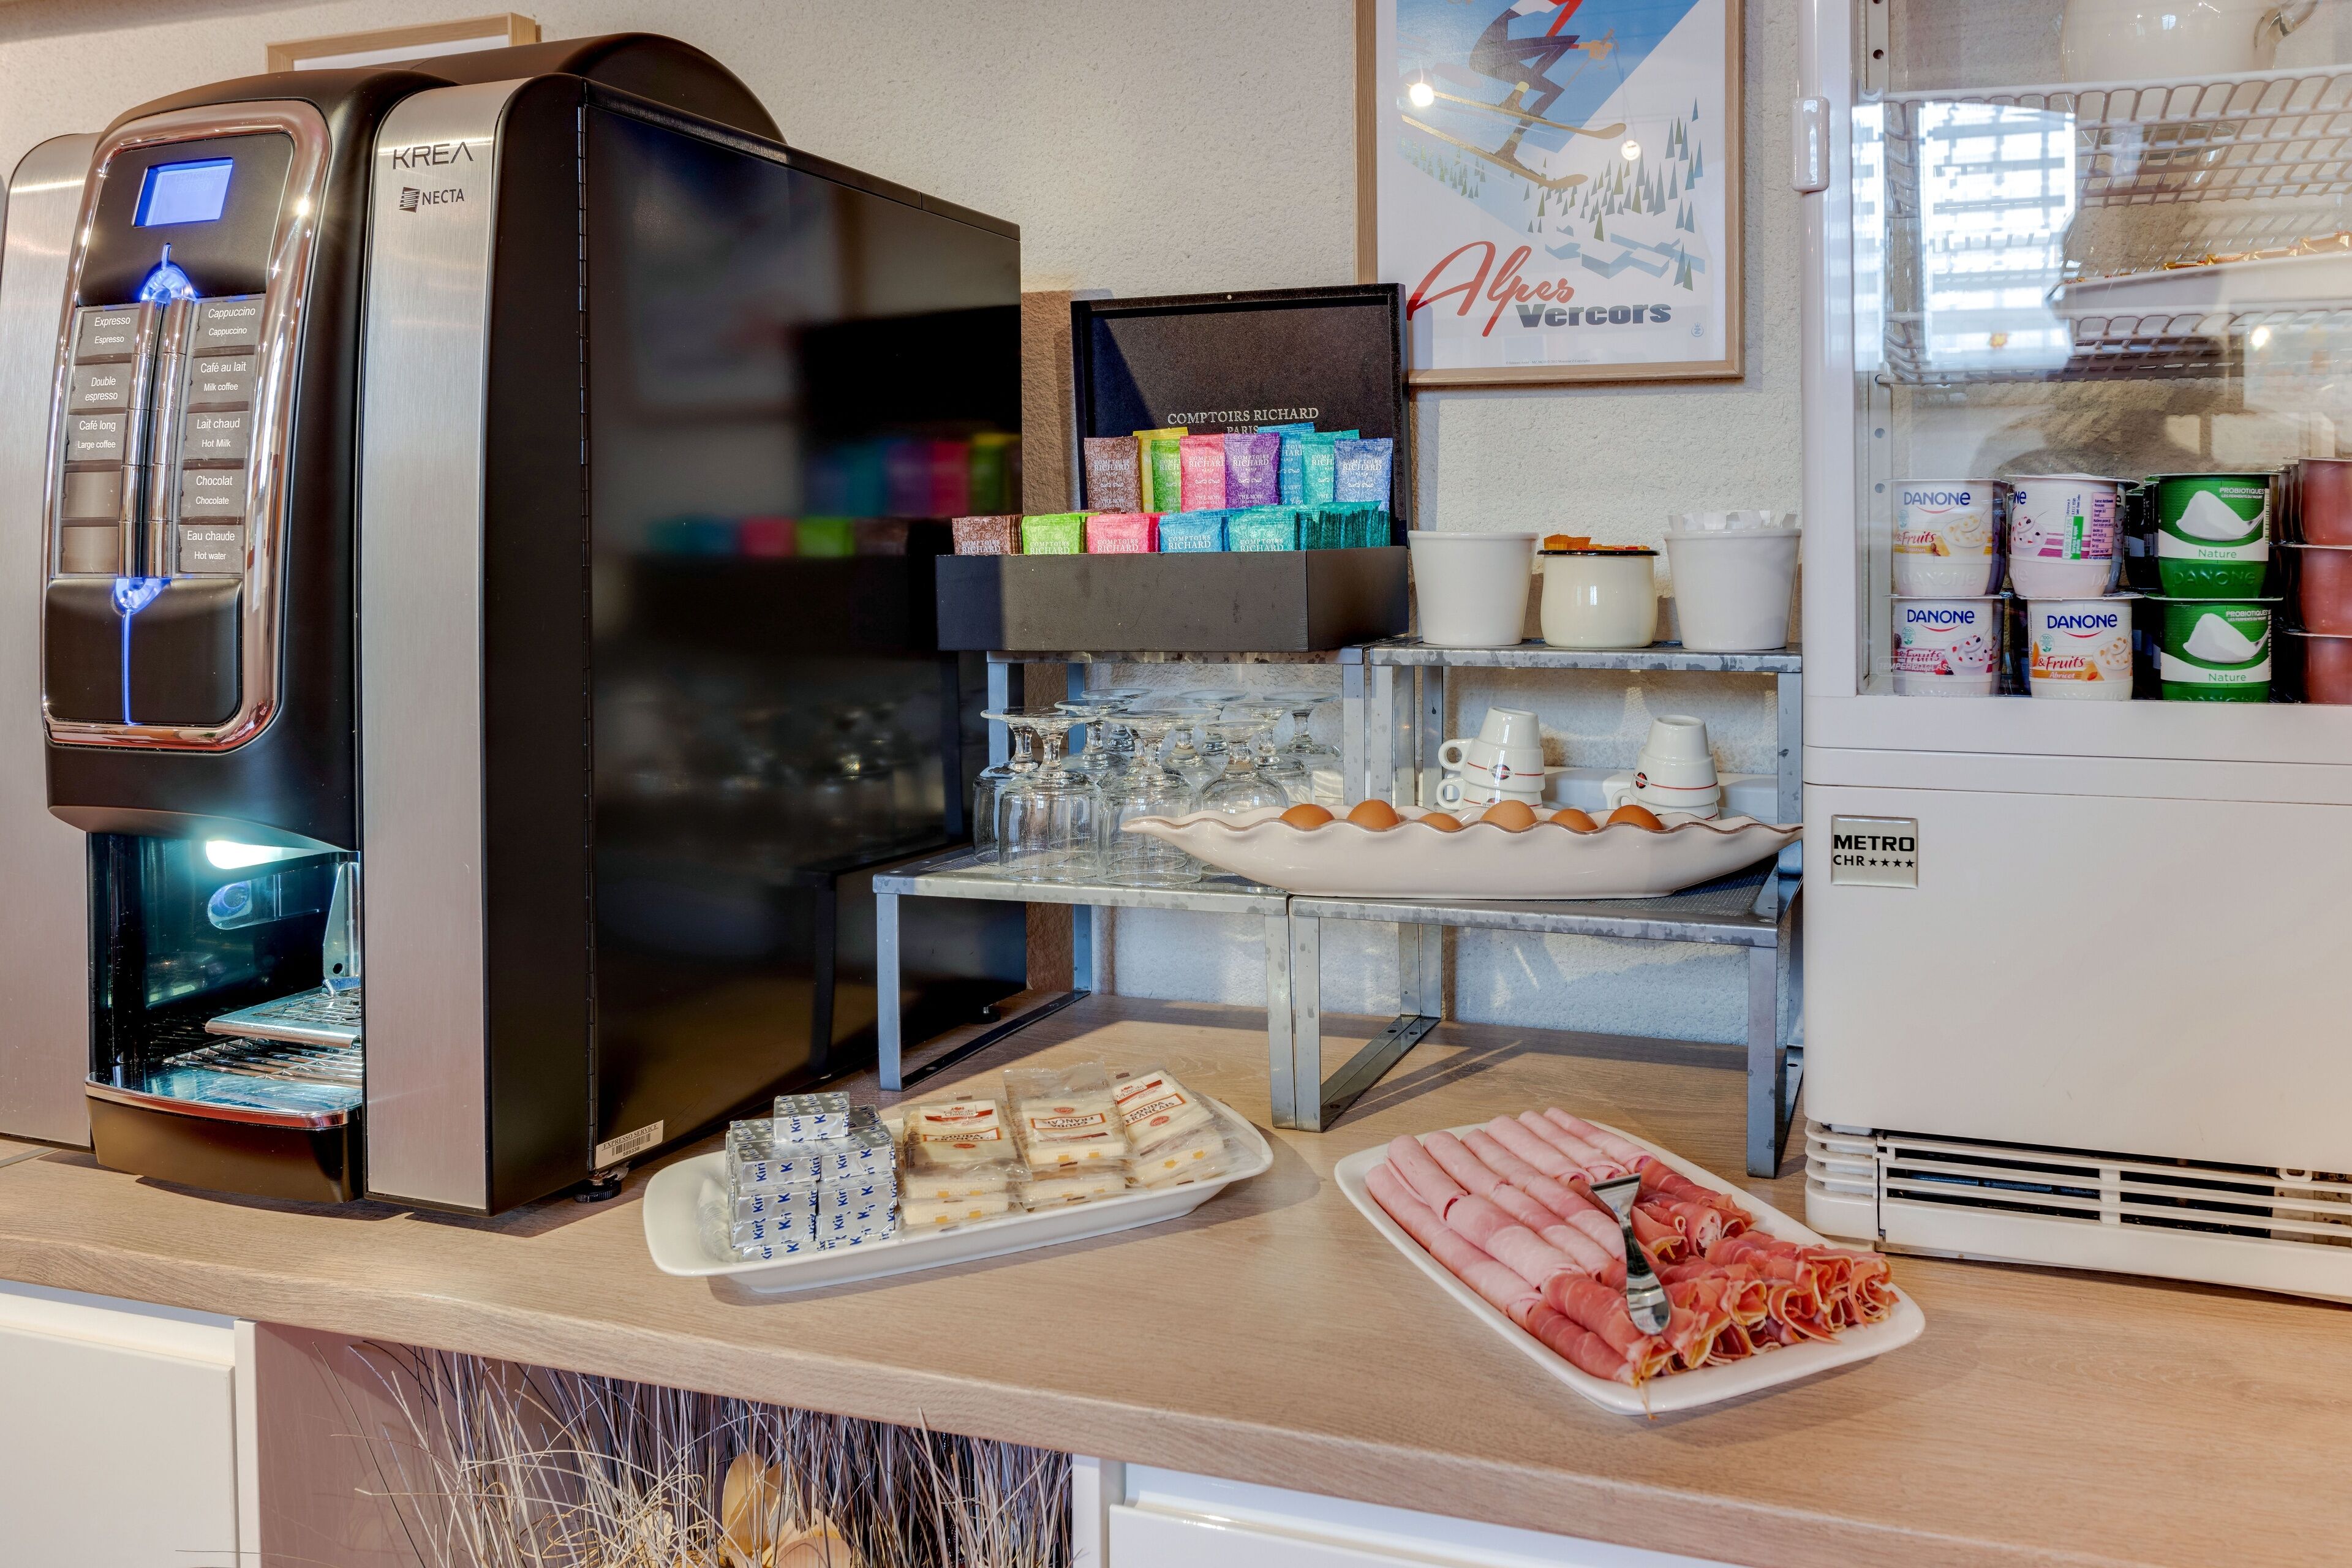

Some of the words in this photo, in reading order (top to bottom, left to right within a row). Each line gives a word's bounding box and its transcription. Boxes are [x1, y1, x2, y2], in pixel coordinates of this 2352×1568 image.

[393, 141, 474, 170] KREA
[422, 188, 465, 206] NECTA
[1406, 241, 1575, 337] Alpes
[208, 306, 256, 320] Cappuccino
[1515, 303, 1672, 328] Vercors
[94, 316, 131, 327] Expresso
[208, 326, 247, 337] Cappuccino
[94, 335, 124, 345] Espresso
[200, 362, 219, 373] Café
[233, 361, 247, 372] lait
[91, 376, 116, 387] Double
[203, 383, 217, 392] Milk
[217, 382, 239, 391] coffee
[85, 391, 118, 402] espresso
[1167, 410, 1250, 424] COMPTOIRS
[1254, 407, 1319, 421] RICHARD
[79, 420, 98, 431] Café
[99, 420, 116, 433] long
[197, 419, 213, 429] Lait
[213, 418, 241, 429] chaud
[1227, 425, 1259, 434] PARIS
[77, 440, 96, 451] Large
[96, 440, 116, 449] coffee
[202, 439, 214, 448] Hot
[216, 439, 232, 448] Milk
[195, 475, 233, 486] Chocolat
[195, 496, 230, 505] Chocolate
[187, 530, 203, 541] Eau
[205, 530, 235, 541] chaude
[1901, 531, 1937, 546] Fruits
[1097, 545, 1139, 553] RICHARD
[1168, 541, 1212, 550] RICHARD
[194, 551, 208, 560] Hot
[208, 552, 227, 560] water
[2198, 549, 2237, 558] Nature
[1904, 649, 1942, 662] Fruits
[2038, 658, 2045, 667] &
[2046, 656, 2086, 671] Fruits
[2208, 673, 2247, 682] Nature
[1833, 834, 1915, 852] METRO
[1833, 854, 1866, 866] CHR
[1129, 1101, 1165, 1117] GOUDA
[603, 1134, 633, 1150] EXPRESSO
[633, 1123, 658, 1137] SERVICE
[754, 1162, 767, 1182] Kiri
[809, 1157, 821, 1176] Kiri
